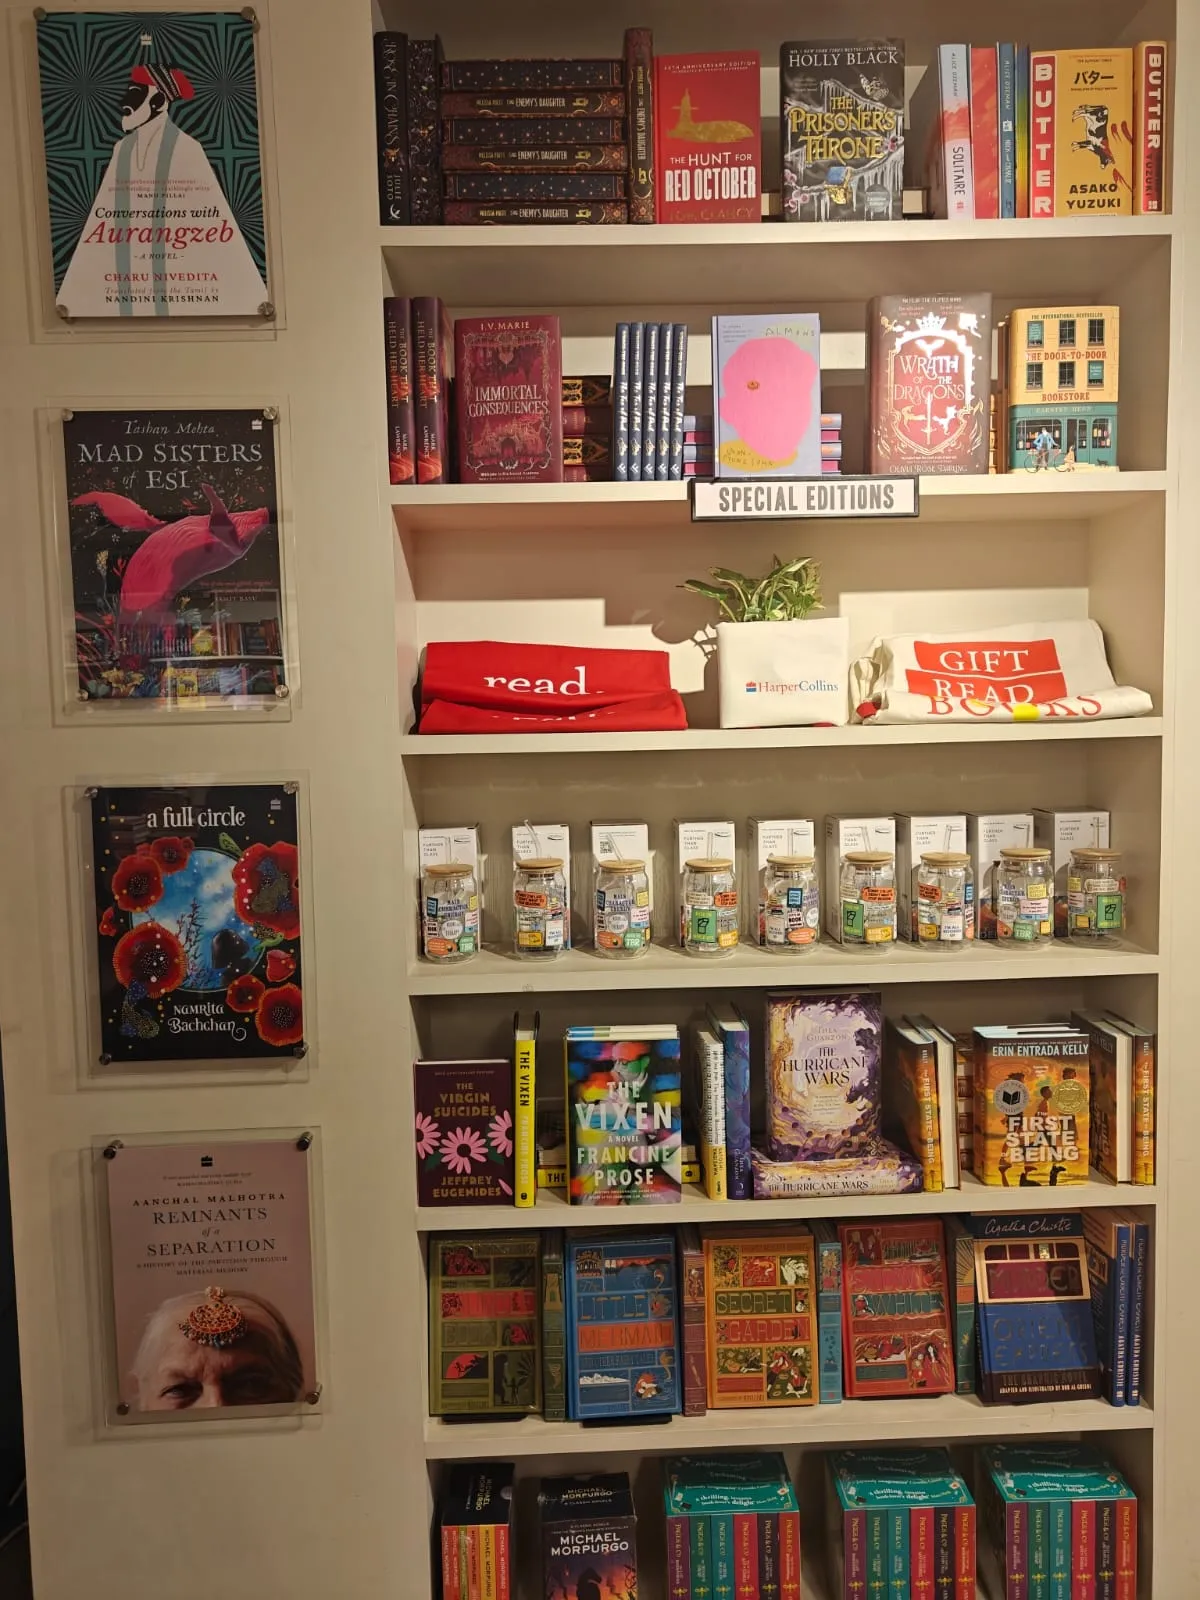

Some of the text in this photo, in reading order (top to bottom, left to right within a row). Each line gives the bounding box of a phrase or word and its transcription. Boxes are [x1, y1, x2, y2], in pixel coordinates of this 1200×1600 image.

[789, 51, 899, 67] HOLLY BLACK
[1074, 70, 1115, 86] バター
[539, 97, 566, 107] DAUGHTER
[831, 96, 853, 110] THE
[1148, 53, 1162, 149] BUTTER
[788, 106, 896, 133] PRISONER'S
[1034, 64, 1053, 214] BUTTER
[541, 150, 568, 160] DAUGHTER
[799, 132, 885, 165] THRONE
[670, 152, 753, 167] THE HUNT FOR
[952, 146, 966, 196] SOLITAIRE
[665, 166, 756, 202] RED OCTOBER
[1069, 183, 1118, 194] ASAKO
[95, 206, 220, 219] Conversations with
[543, 208, 569, 218] DAUGHTER
[1066, 198, 1121, 210] YUZUKI
[84, 219, 234, 250] Aurangzeb
[104, 272, 218, 281] CHARU NIVEDITA
[105, 295, 219, 303] NANDINI KRISHNAN
[388, 321, 397, 349] HELD
[390, 351, 398, 373] HER
[399, 343, 408, 373] BOOK
[428, 342, 436, 373] BOOK
[1026, 351, 1108, 362] THE DOOR-TO-DOOR
[900, 355, 960, 380] WRATH
[913, 375, 953, 385] OF THE
[475, 384, 542, 402] IMMORTAL
[894, 383, 965, 405] DRAGONS
[1041, 392, 1091, 402] BOOKSTORE
[468, 400, 549, 418] CONSEQUENCES
[176, 422, 216, 435] Mehta
[78, 443, 263, 463] MAD SISTERS
[122, 470, 191, 491] of ESI
[719, 484, 895, 512] SPECIAL EDITIONS
[939, 649, 1030, 674] GIFT
[758, 679, 839, 695] HarperCollins
[934, 678, 1035, 705] READ
[147, 806, 247, 828] a full circle
[167, 1015, 247, 1042] Bachchan
[818, 1046, 837, 1057] THE
[992, 1043, 1089, 1057] ERIN ENTRADA KELLY
[782, 1055, 870, 1073] HURRICANE
[455, 1082, 474, 1090] THE
[519, 1051, 530, 1107] THE VIXEN
[804, 1070, 851, 1088] WARS
[439, 1092, 491, 1104] VIRGIN
[606, 1081, 641, 1099] THE
[433, 1105, 497, 1118] SUICIDES
[574, 1101, 672, 1131] VIXEN
[1143, 1096, 1151, 1125] STATE
[923, 1077, 935, 1164] FIRST STATE BEING
[1007, 1115, 1073, 1132] FIRST
[608, 1135, 640, 1143] A NOVEL
[1005, 1131, 1076, 1148] STATE
[577, 1146, 671, 1165] FRANCINE
[1009, 1145, 1079, 1163] BEING
[441, 1175, 493, 1186] JEFFREY
[547, 1172, 566, 1183] THE
[594, 1168, 655, 1187] PROSE
[768, 1180, 869, 1192] THE HURRICANE WARS
[132, 1192, 286, 1207] AANCHAL MALHOTRA
[432, 1186, 501, 1198] EUGENIDES
[153, 1207, 268, 1226] REMNANTS
[201, 1226, 212, 1237] of
[984, 1216, 1073, 1237] Agatha Christie
[147, 1238, 277, 1257] SEPARATION
[716, 1292, 792, 1314] SECRET
[727, 1319, 810, 1343] GARDEN
[1117, 1335, 1125, 1359] AGATHA
[1116, 1360, 1125, 1387] CHRISTIE
[562, 1490, 613, 1499] MORPURGO
[560, 1532, 621, 1546] MICHAEL
[551, 1541, 630, 1557] MORPURGO
